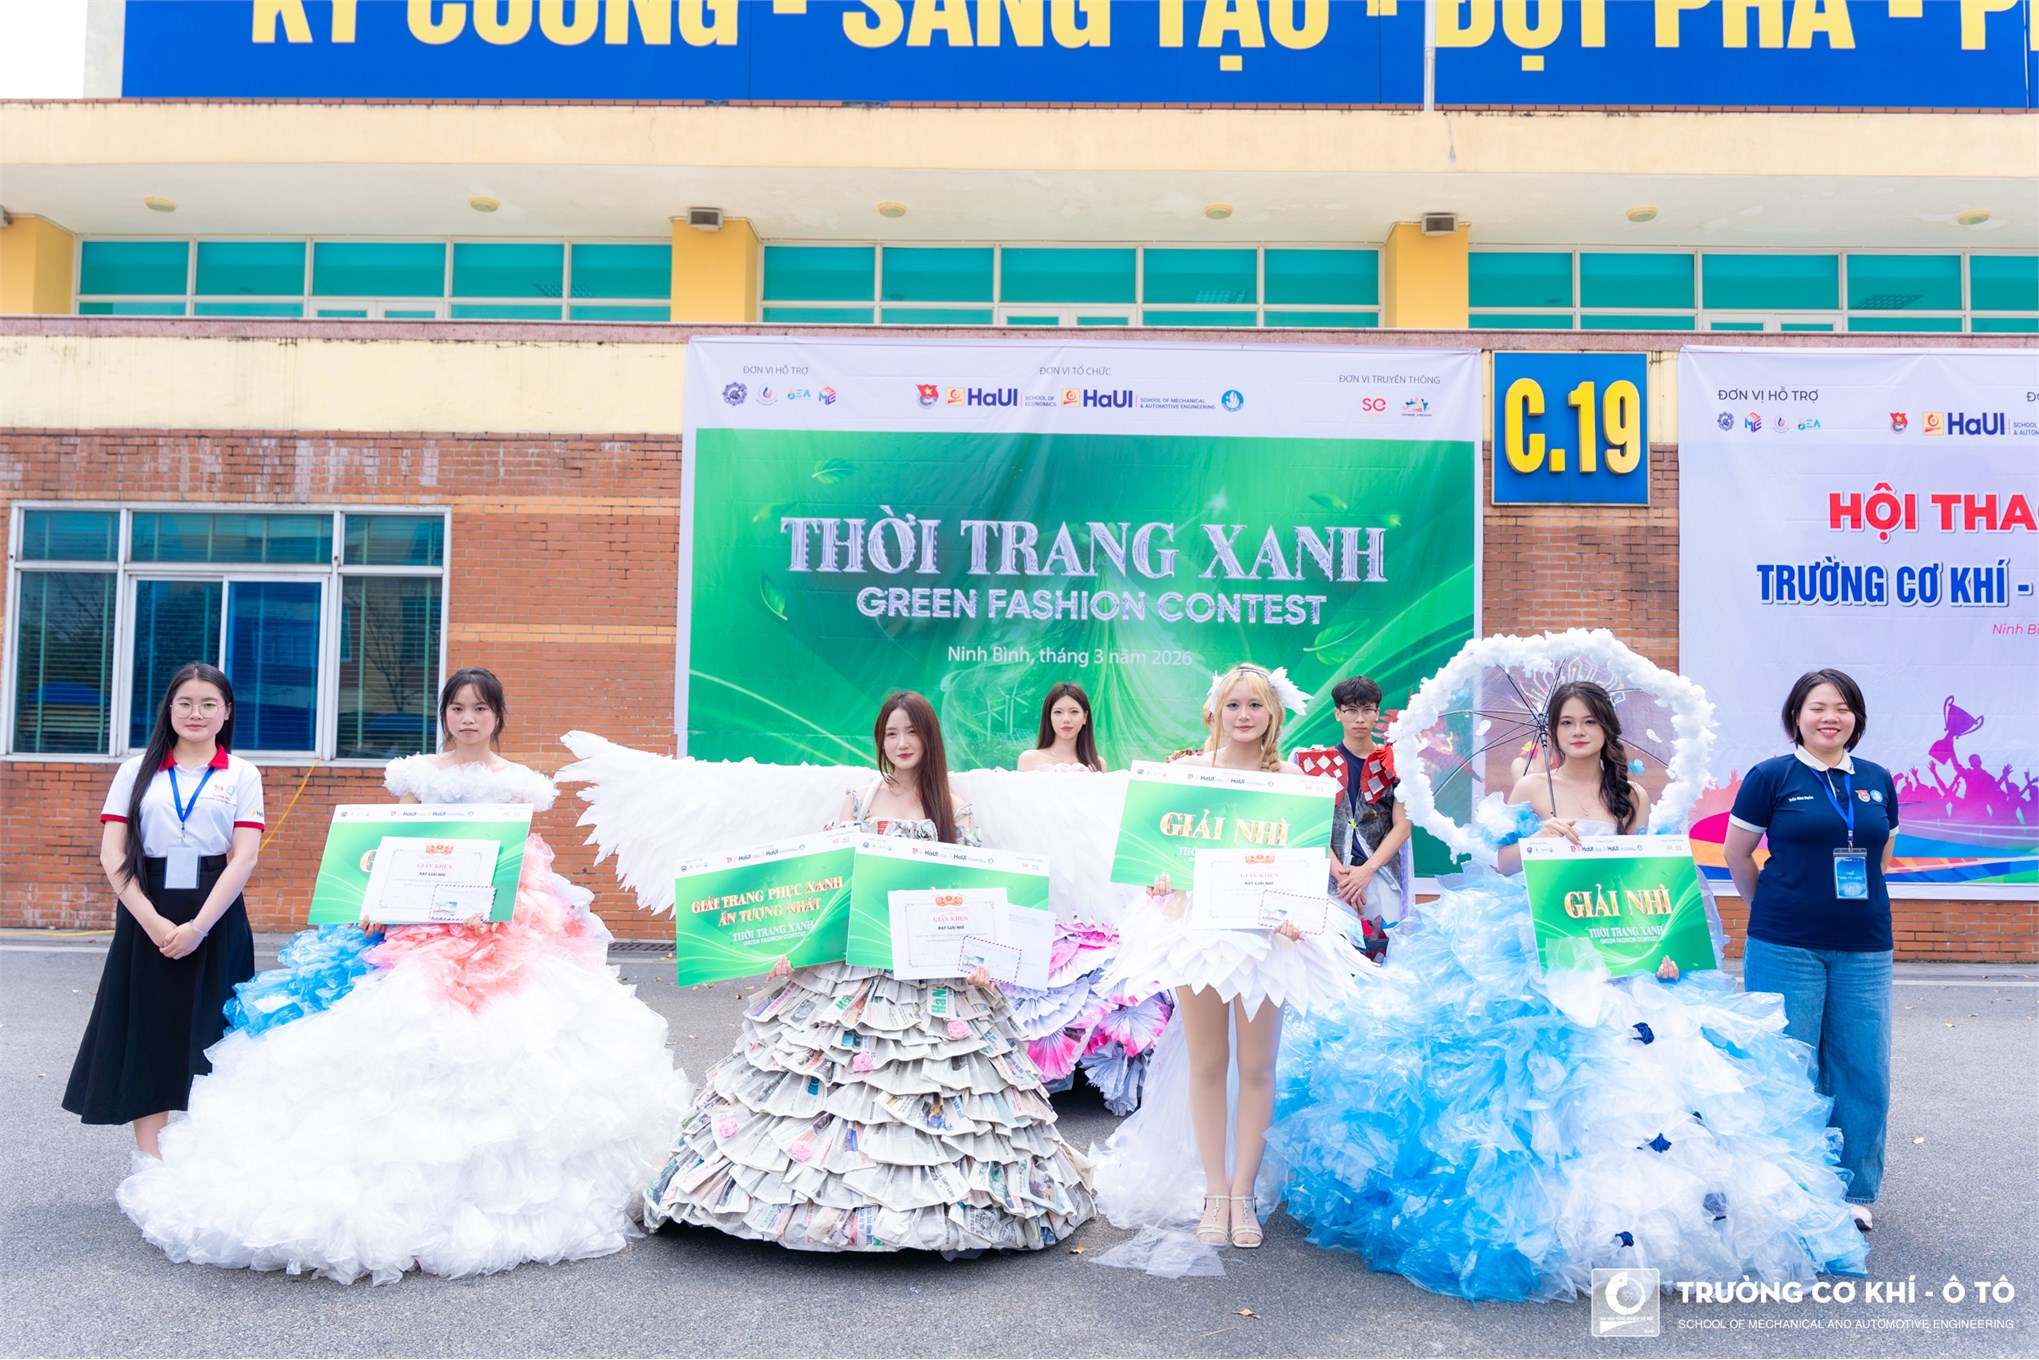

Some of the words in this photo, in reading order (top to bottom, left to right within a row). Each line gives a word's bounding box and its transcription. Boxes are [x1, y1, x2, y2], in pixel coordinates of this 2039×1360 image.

[743, 366, 763, 374] ĐƠN
[765, 366, 774, 375] VỊ
[775, 364, 789, 374] HỖ
[791, 366, 809, 376] TRỢ
[1039, 366, 1060, 375] ĐƠN
[1062, 367, 1070, 376] VỊ
[1072, 365, 1084, 375] TỔ
[1086, 365, 1111, 376] CHỨC
[1338, 374, 1359, 383] ĐƠN
[1361, 375, 1370, 384] VỊ
[1372, 373, 1406, 384] TRUYỀN
[1408, 374, 1440, 384] THÔNG
[967, 388, 1018, 406] HaUI
[1083, 389, 1133, 408] HaUI
[1718, 388, 1748, 400] ĐƠN
[1752, 390, 1764, 404] VỊ
[1768, 386, 1788, 401] HỖ
[1791, 389, 1819, 404] TRỢ
[2026, 391, 2039, 402] Đ
[1505, 377, 1641, 474] C.19
[1947, 412, 2005, 435] HaUI
[1828, 482, 1917, 541] HỘI
[1931, 494, 2039, 531] THA
[780, 504, 941, 574] THỜI
[960, 519, 1180, 579] TRANG
[1197, 523, 1389, 582] XANH
[1756, 556, 1885, 603] TRƯỜNG
[1896, 563, 1939, 603] CƠ
[1950, 559, 2006, 603] KHÍ
[856, 586, 977, 618] GREEN
[987, 588, 1146, 621] FASHION
[1157, 591, 1327, 625] CONTEST
[1992, 623, 2023, 635] Ninh
[947, 645, 988, 662] Ninh
[992, 645, 1035, 665] Bình,
[1038, 648, 1089, 667] tháng
[1094, 649, 1103, 663] 3
[1110, 648, 1146, 665] năm
[1151, 650, 1193, 666] 2026
[1159, 809, 1226, 841] GIẢI
[1233, 817, 1292, 846] NHÌ
[691, 896, 721, 913] GIẢI
[721, 890, 765, 909] TRANG
[768, 883, 803, 901] PHỤC
[804, 876, 843, 895] XANH
[1563, 883, 1621, 919] GIẢI
[1625, 883, 1674, 917] NHÌ
[718, 909, 737, 927] ẤN
[739, 904, 783, 922] TƯỢNG
[786, 896, 822, 915] NHẤT
[732, 929, 755, 942] THỜI
[756, 925, 786, 938] TRANG
[788, 920, 814, 932] XANH
[1588, 926, 1610, 938] THỜI
[1610, 926, 1639, 937] TRANG
[1640, 926, 1663, 936] XANH
